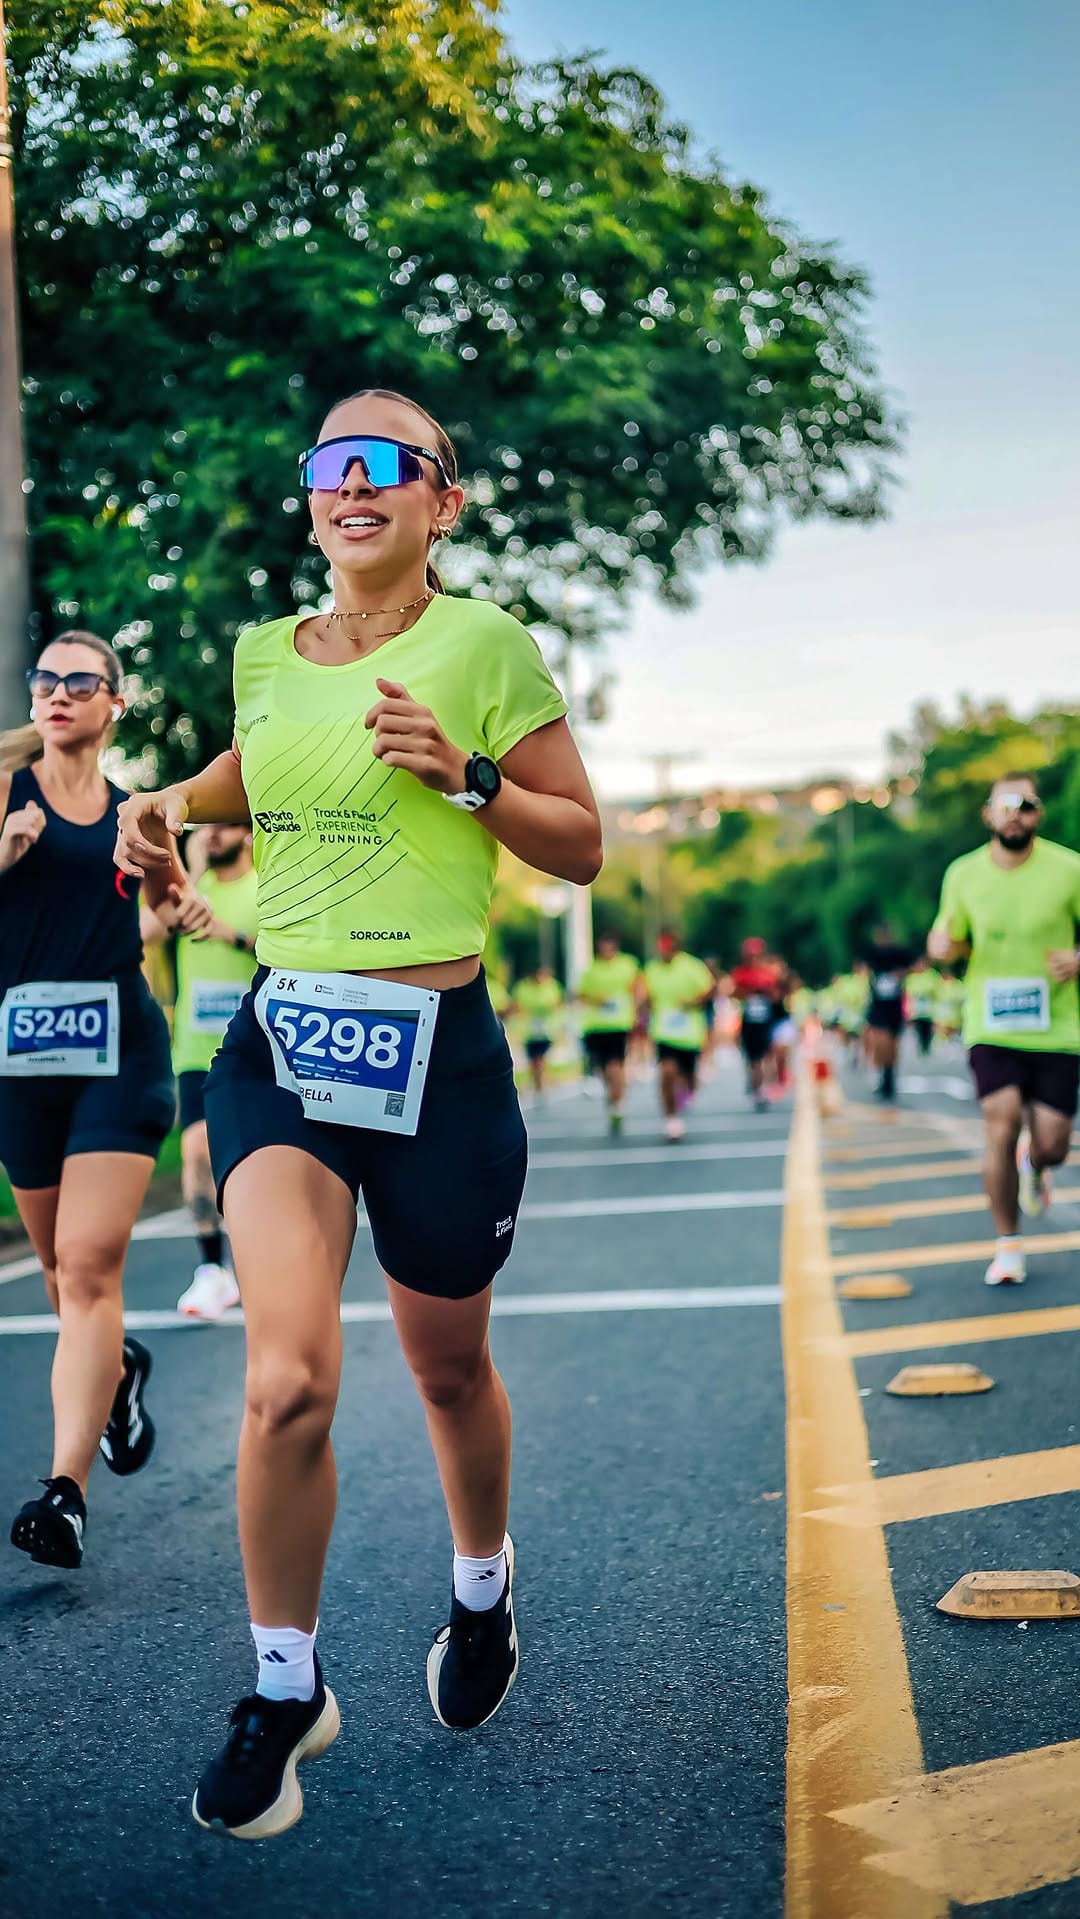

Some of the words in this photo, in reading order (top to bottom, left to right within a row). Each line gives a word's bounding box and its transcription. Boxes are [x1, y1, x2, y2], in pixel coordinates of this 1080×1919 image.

[268, 810, 294, 821] Porto
[316, 821, 377, 833] EXPERIENCE
[320, 834, 383, 845] RUNNING
[350, 931, 411, 940] SOROCABA
[13, 1007, 102, 1039] 5240
[274, 1007, 402, 1069] 5298
